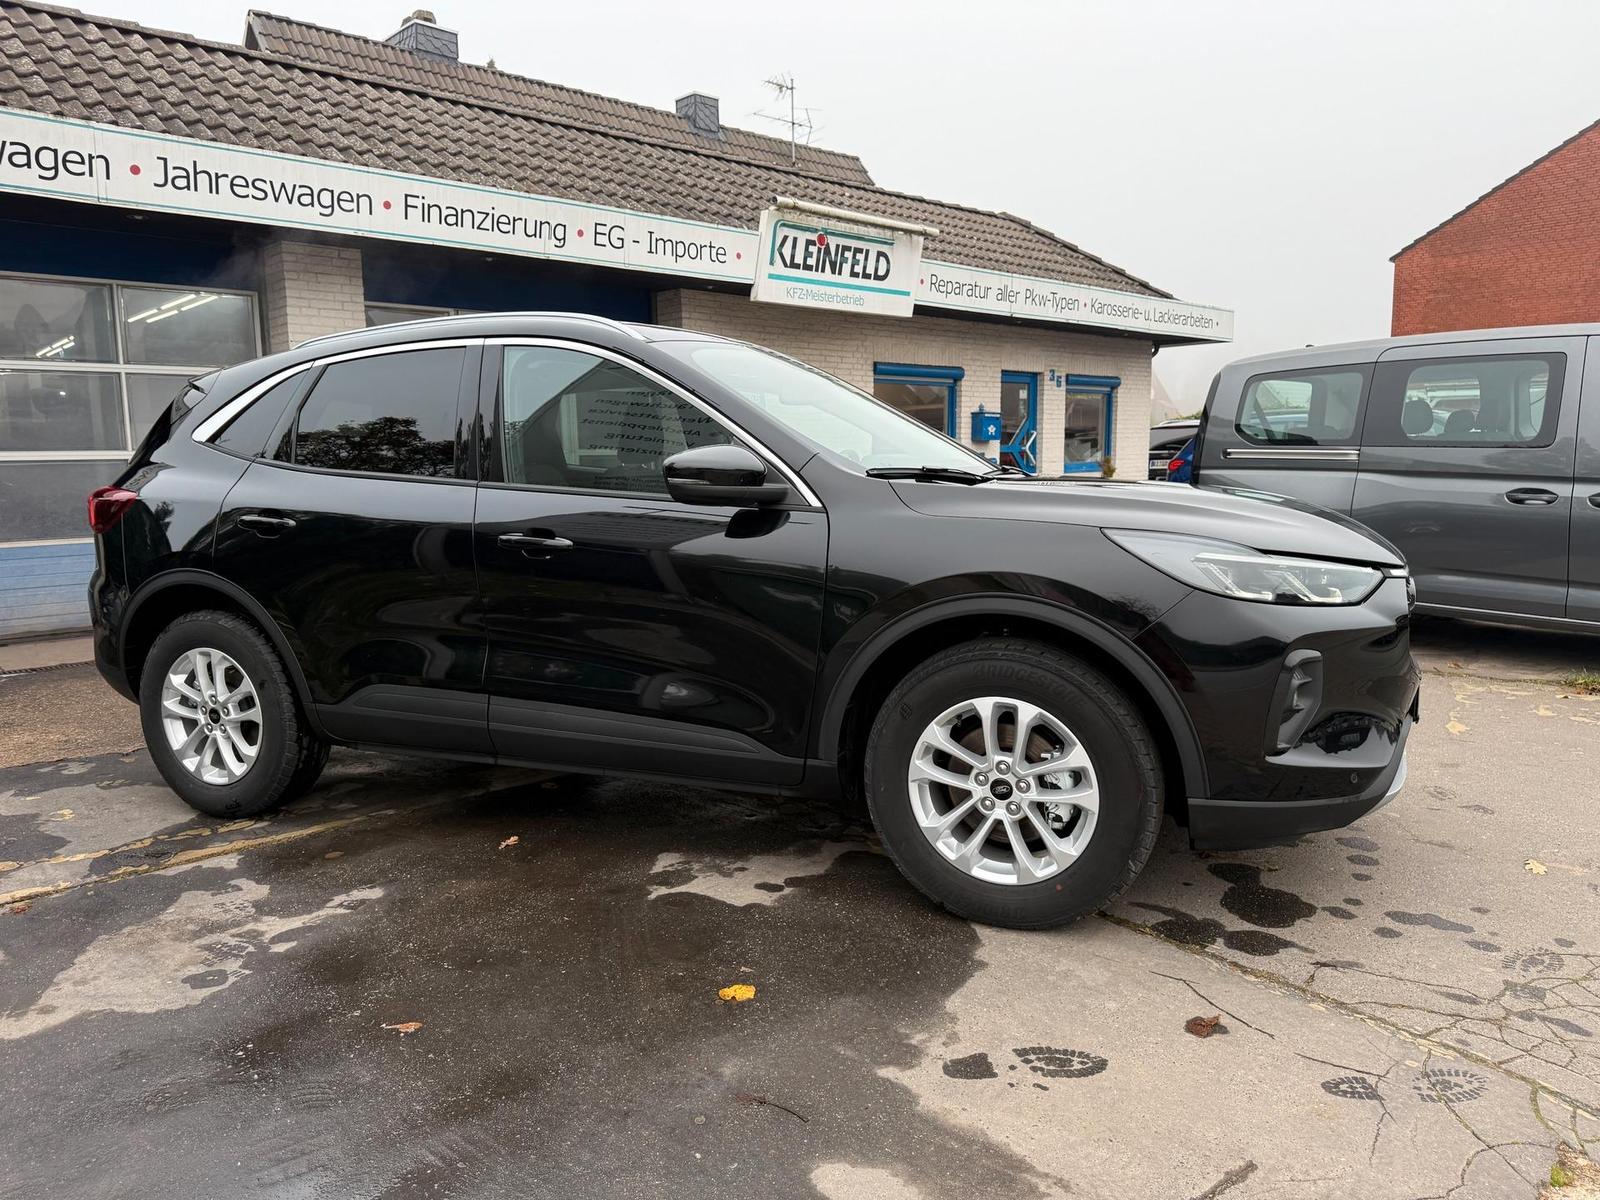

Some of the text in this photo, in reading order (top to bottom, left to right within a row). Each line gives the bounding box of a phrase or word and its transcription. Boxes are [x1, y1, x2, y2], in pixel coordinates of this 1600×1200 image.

[0, 140, 110, 181] agen
[153, 156, 373, 217] Jahreswagen
[403, 193, 567, 248] Finanzierung
[593, 222, 625, 250] EG
[647, 230, 727, 264] Importe
[776, 233, 891, 282] KLEINFELD
[786, 286, 865, 306] KFZ-Meisterbetrieb
[929, 273, 992, 298] Reparatur
[995, 284, 1020, 303] aller
[1024, 288, 1080, 313] Pkw-Typen
[1153, 307, 1214, 329] Lackierarbeiten
